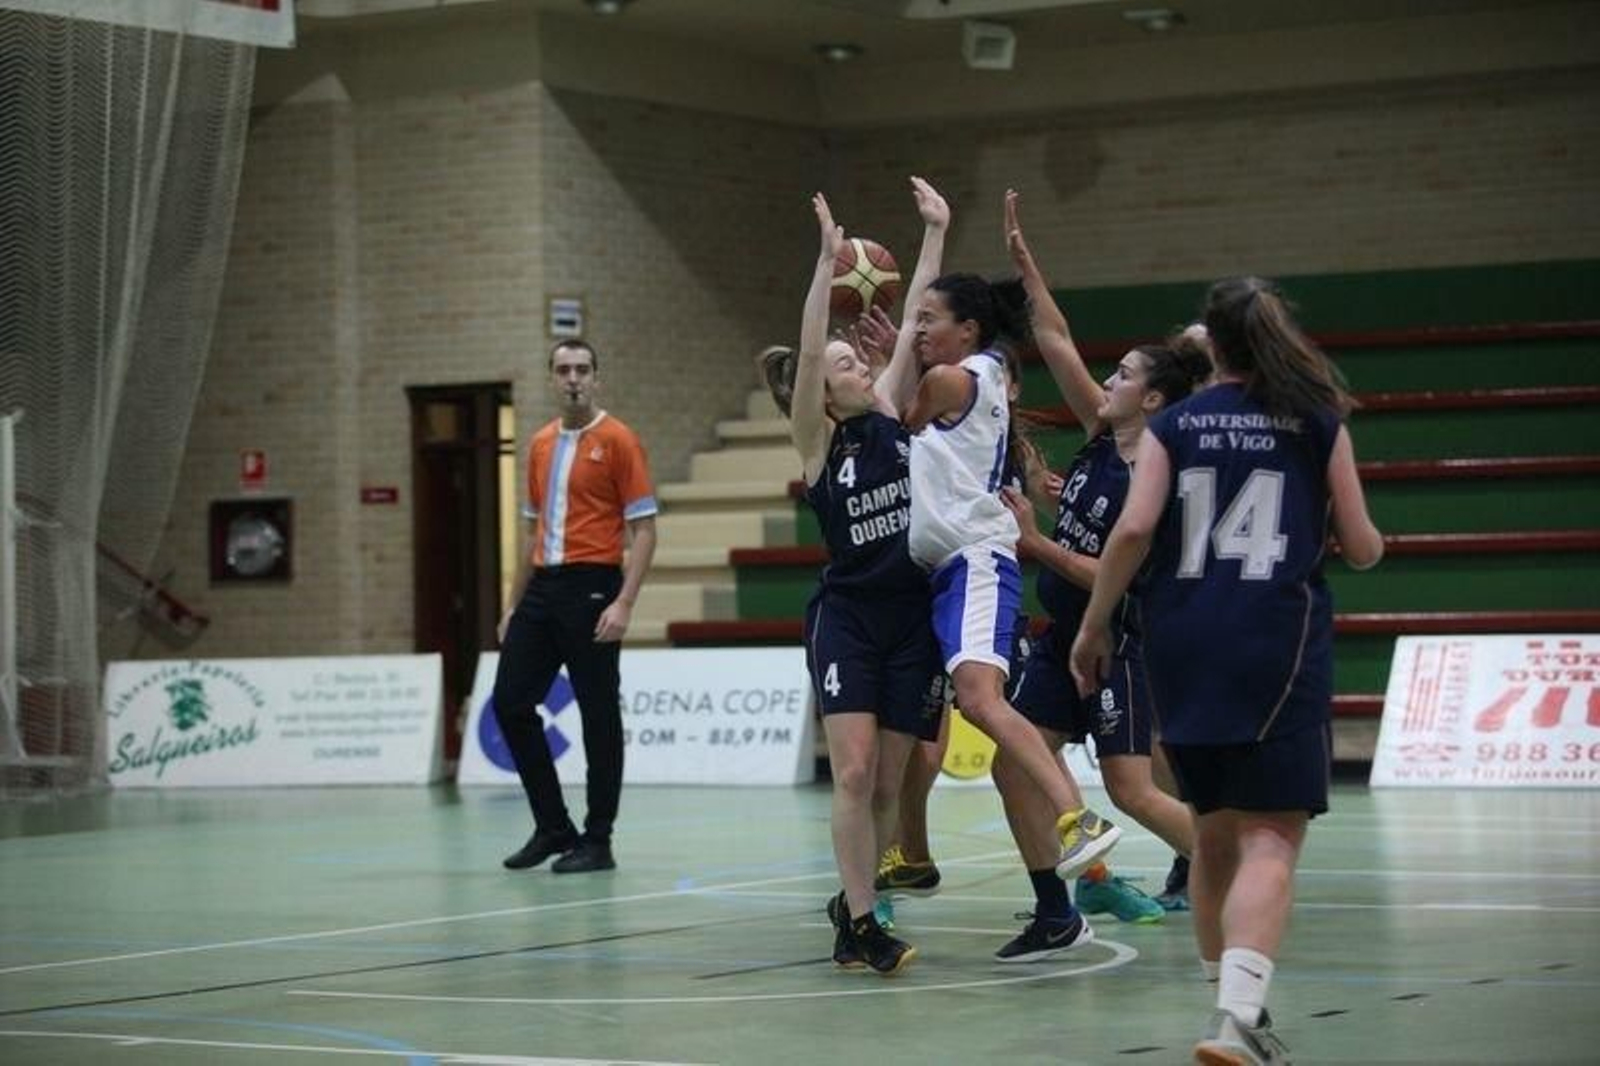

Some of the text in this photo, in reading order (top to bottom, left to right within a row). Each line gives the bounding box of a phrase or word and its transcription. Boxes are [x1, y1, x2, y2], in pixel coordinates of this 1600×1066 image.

[1178, 411, 1304, 434] UNIVERSIDADE
[1200, 434, 1222, 450] DE
[837, 457, 857, 488] 4
[846, 478, 911, 518] CAMPU
[850, 507, 911, 546] OUREN
[1176, 467, 1288, 580] 14
[823, 662, 842, 697] 4
[722, 689, 801, 715] COPE
[108, 718, 260, 779] Salgueiros
[761, 728, 793, 746] FM
[1476, 741, 1548, 763] 988
